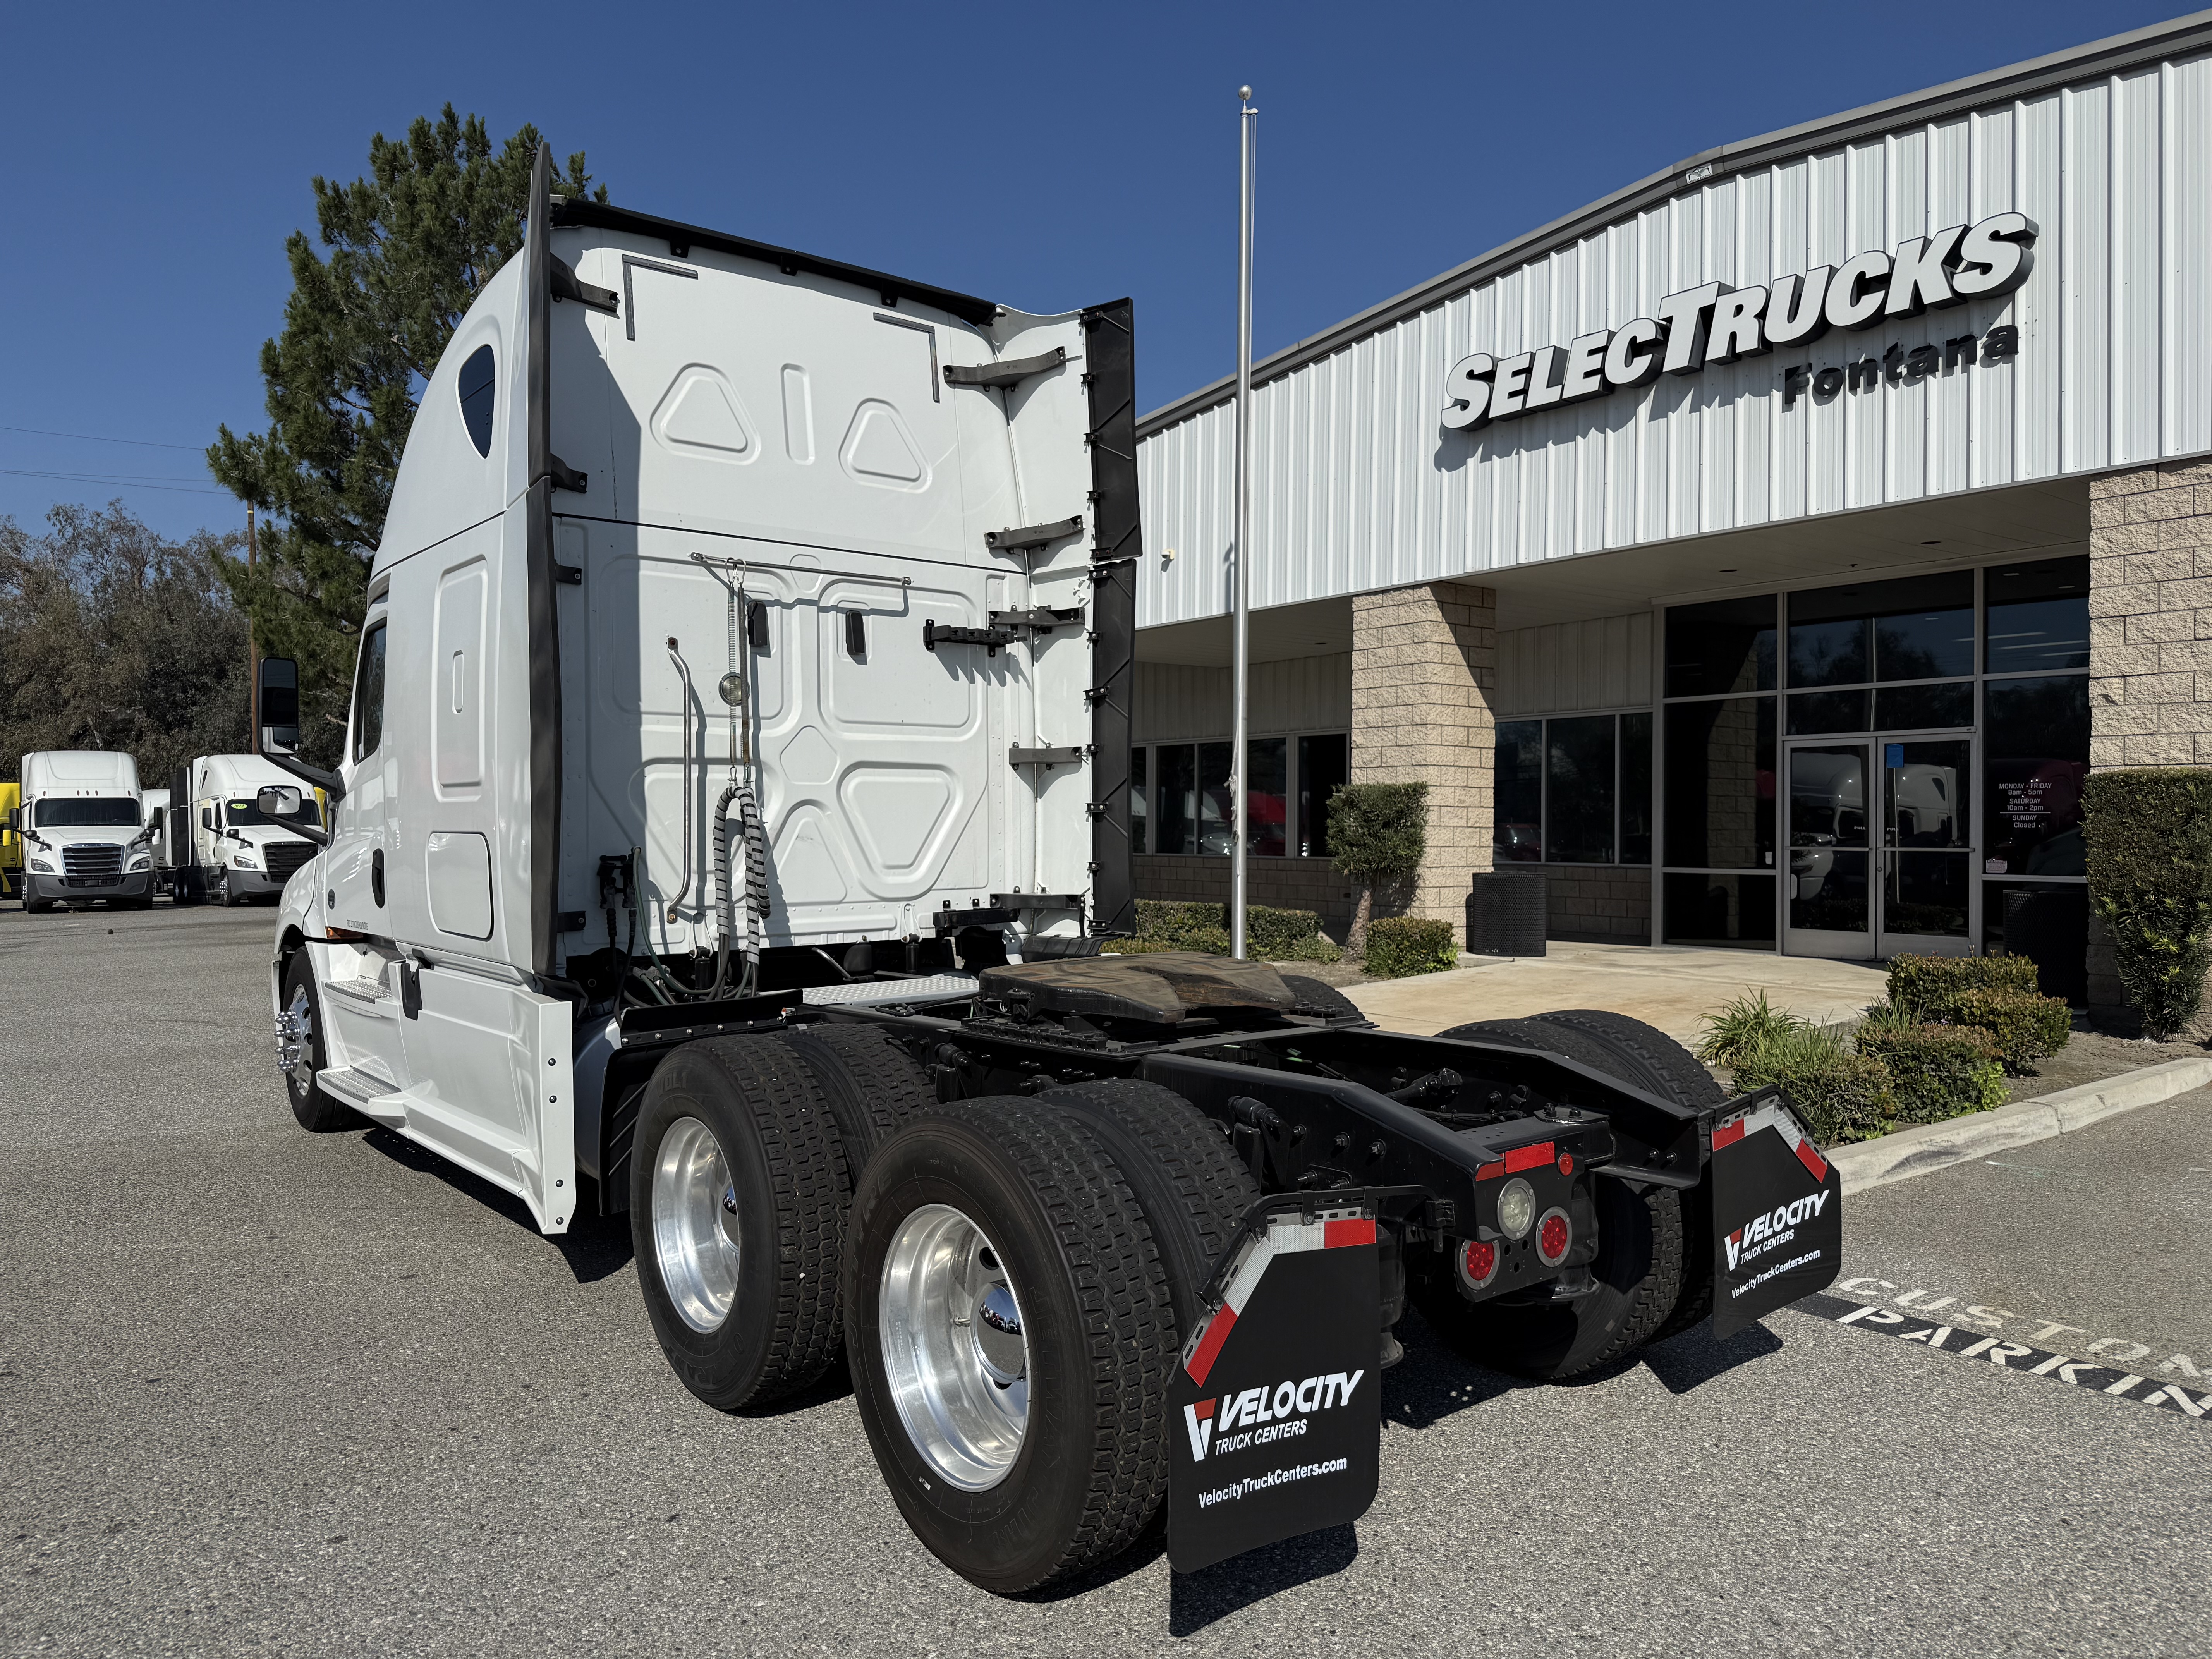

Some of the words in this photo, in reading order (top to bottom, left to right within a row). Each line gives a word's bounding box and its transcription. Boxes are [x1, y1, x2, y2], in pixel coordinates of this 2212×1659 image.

[1441, 211, 2039, 431] SELECTRUCKS
[1784, 325, 2019, 404] Fontana
[1741, 1243, 1762, 1264] TRUCK
[1762, 1228, 1795, 1252] CENTERS
[1742, 1189, 1830, 1249] VELOCITY
[1731, 1249, 1820, 1299] VelocityTruckCenters.com
[1835, 1306, 2212, 1417] PARKIN
[1219, 1369, 1365, 1432] VELOCITY
[1215, 1431, 1253, 1456] TRUCK
[1254, 1418, 1308, 1445] CENTERS
[1199, 1457, 1348, 1508] VelocityTruckCenters.com
